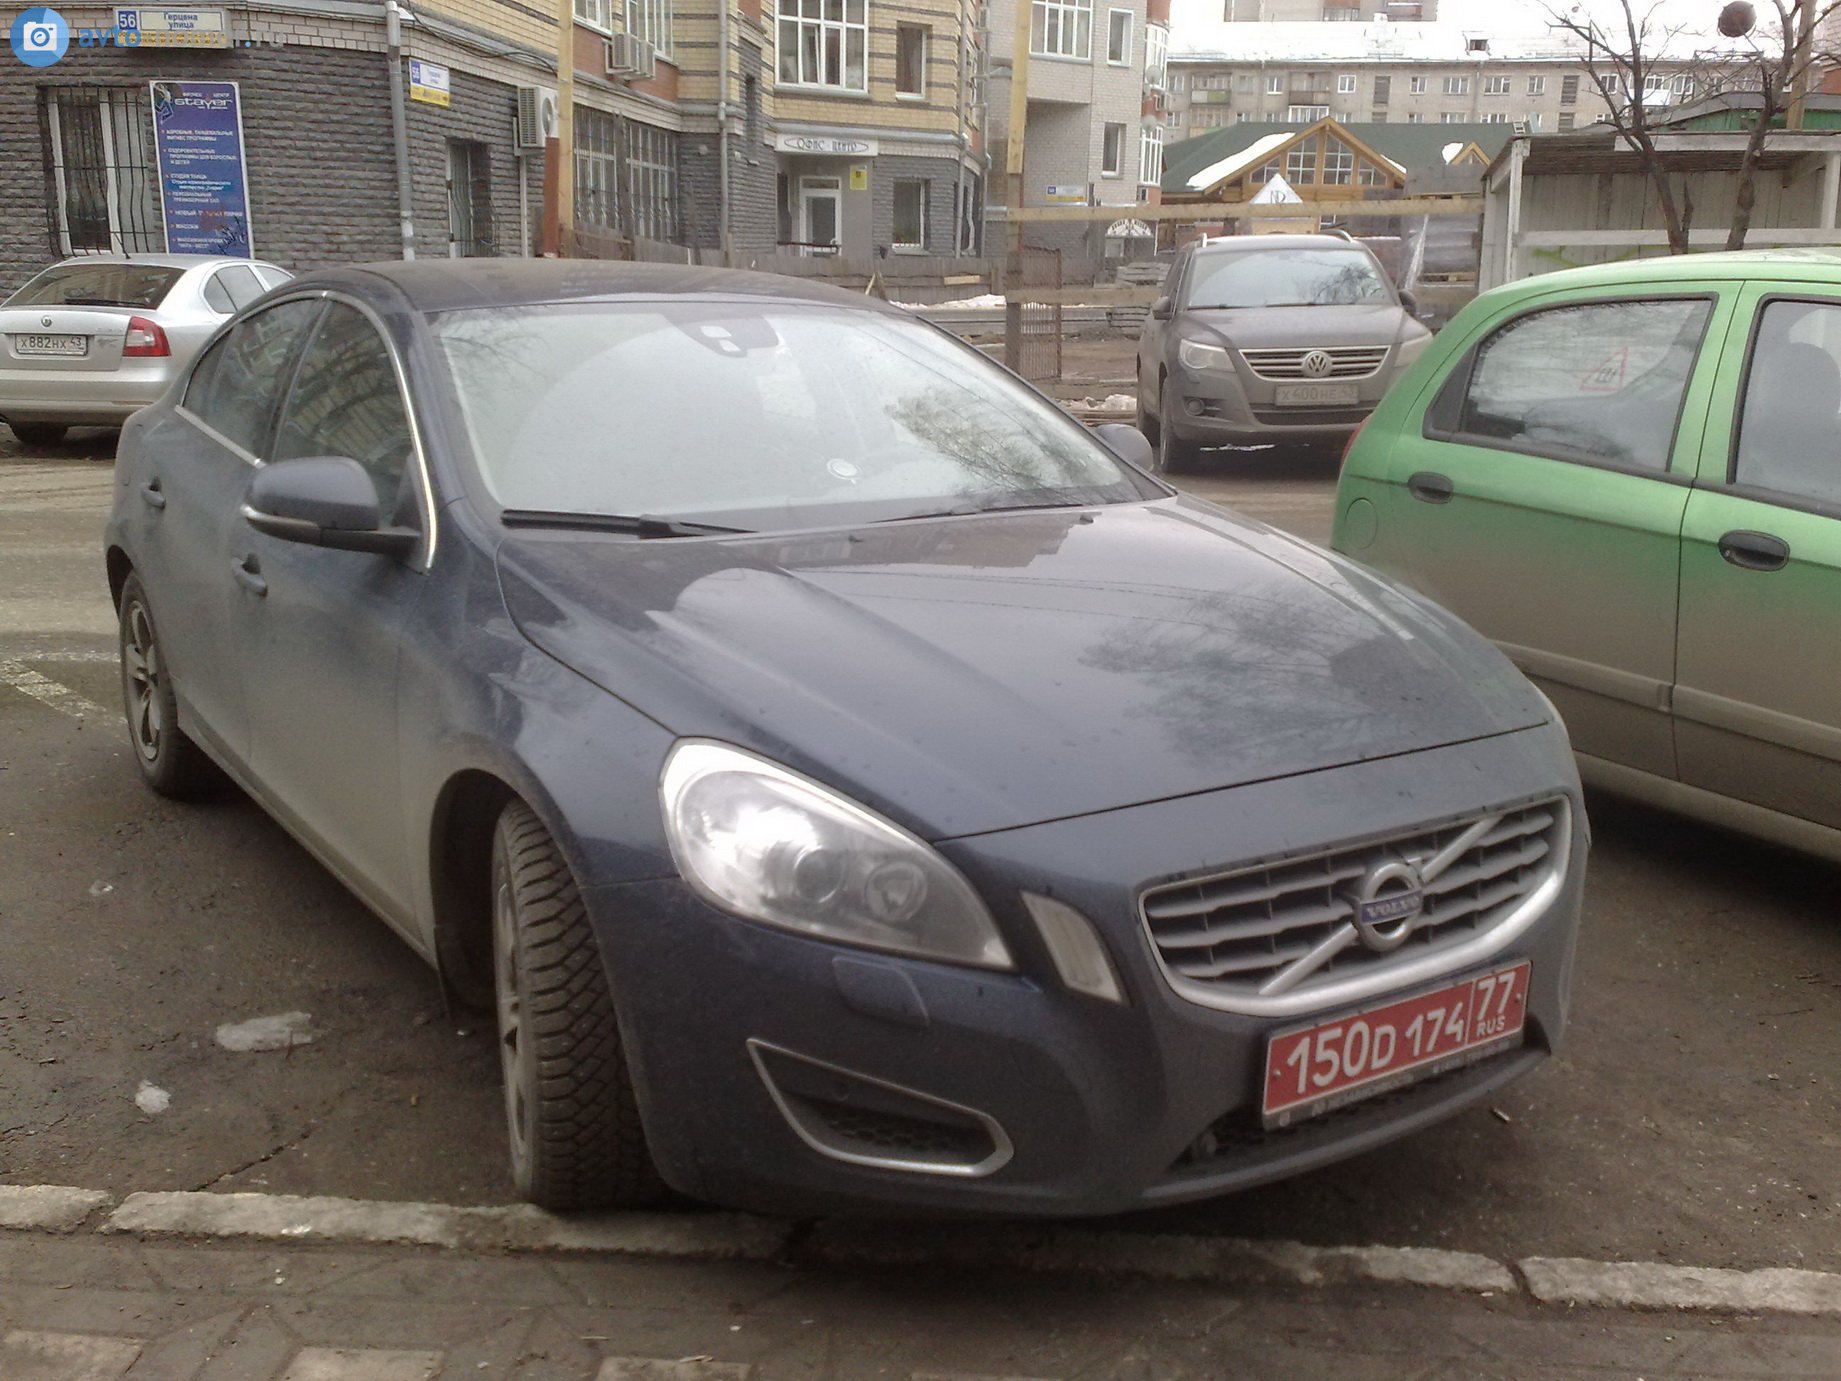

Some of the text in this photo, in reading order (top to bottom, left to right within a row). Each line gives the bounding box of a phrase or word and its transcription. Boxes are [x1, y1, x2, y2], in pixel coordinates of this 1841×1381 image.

[119, 13, 137, 28] 56
[168, 22, 194, 30] улица
[1366, 894, 1421, 918] VOLVO
[1476, 971, 1517, 1021] 77
[1476, 1015, 1506, 1038] RUS
[1287, 1021, 1396, 1094] 150D
[1405, 1001, 1465, 1057] 174
